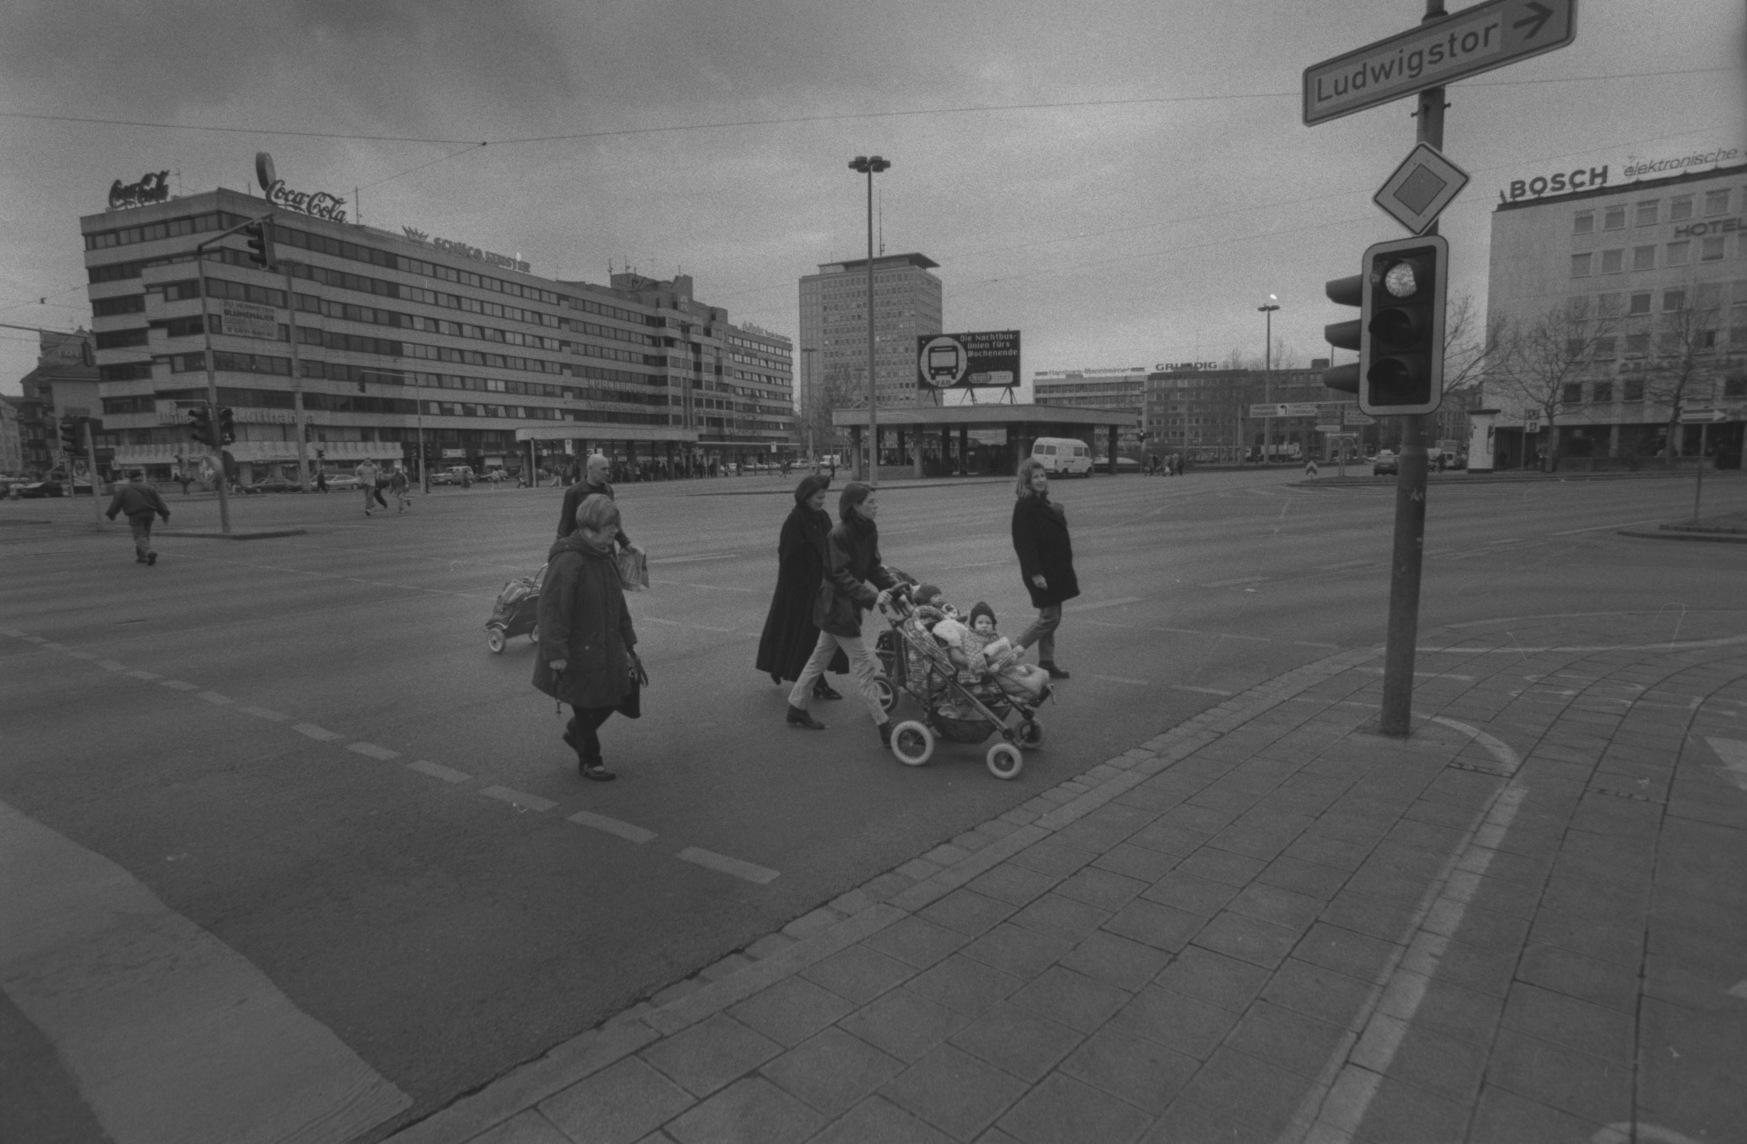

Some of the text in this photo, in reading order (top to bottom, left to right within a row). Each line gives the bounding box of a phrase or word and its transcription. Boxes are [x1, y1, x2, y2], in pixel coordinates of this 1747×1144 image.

[1317, 22, 1499, 103] Ludwigstor
[1624, 148, 1739, 177] elektronische
[1510, 165, 1608, 199] BOSCH
[1673, 217, 1747, 240] HOTEL
